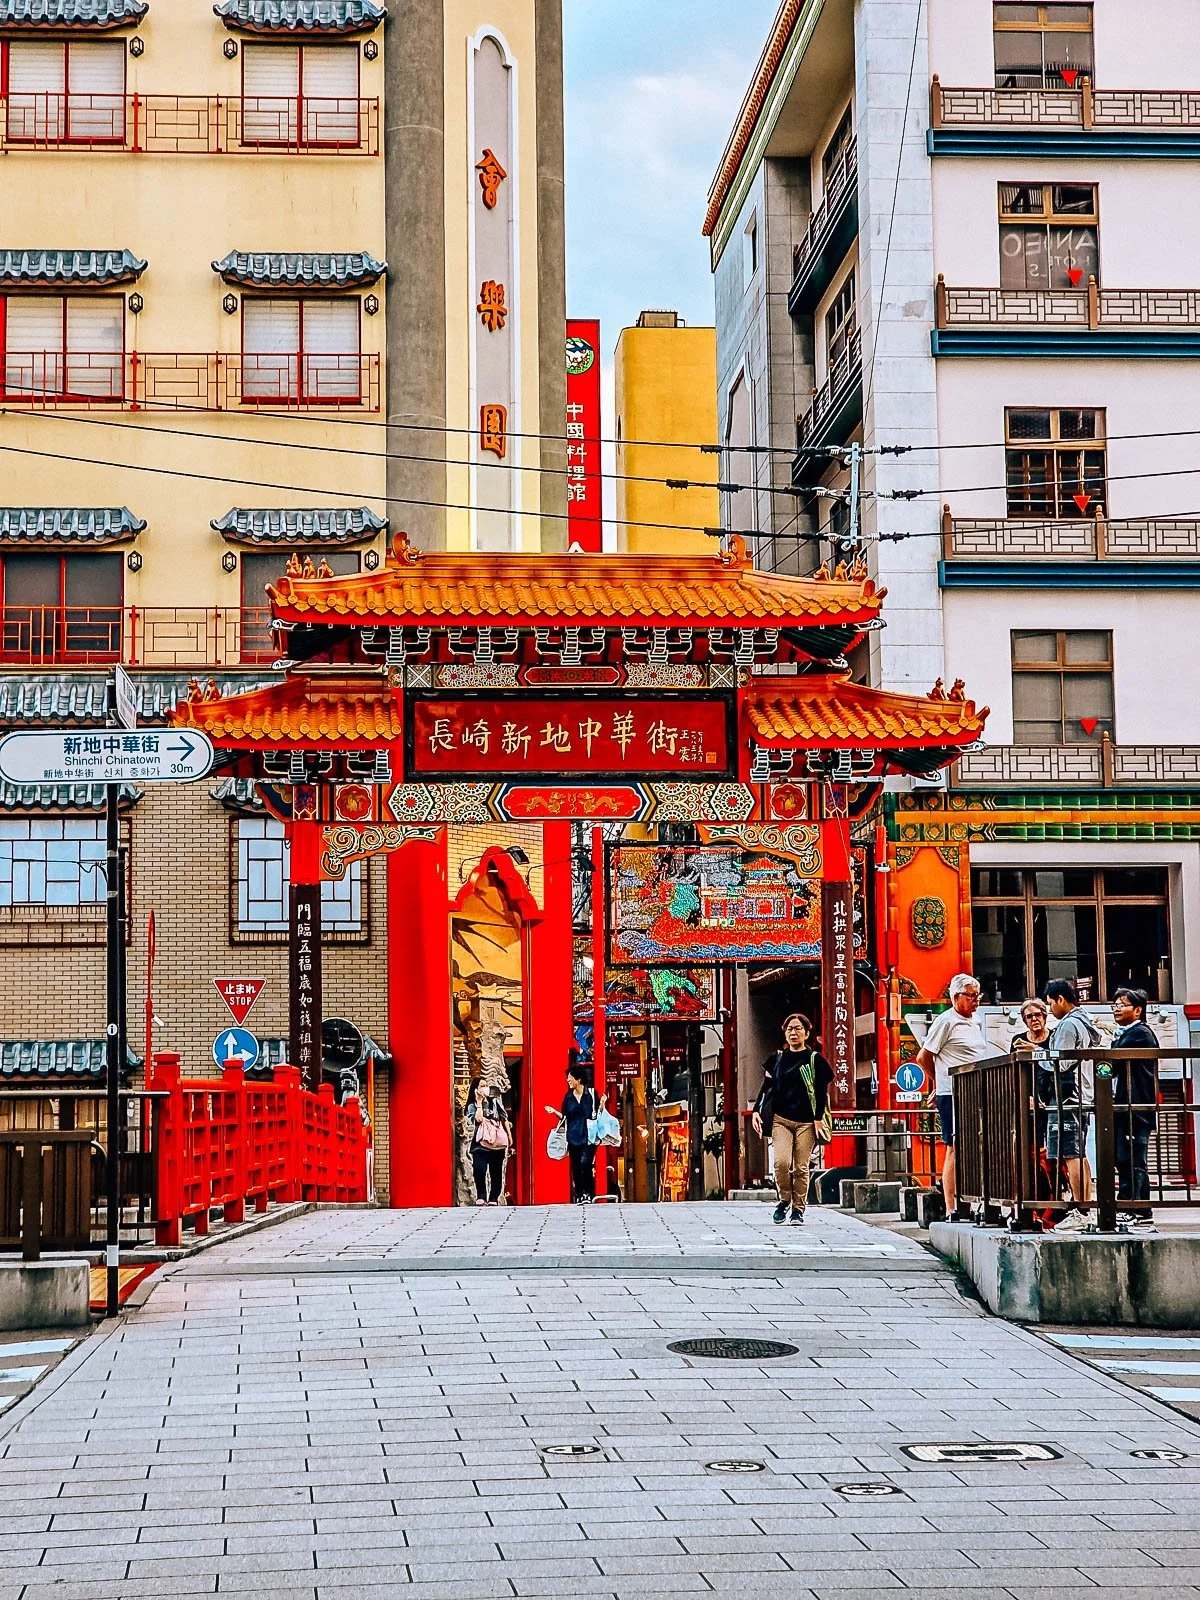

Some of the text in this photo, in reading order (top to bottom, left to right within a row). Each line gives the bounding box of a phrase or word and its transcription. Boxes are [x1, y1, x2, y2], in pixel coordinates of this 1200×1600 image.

[429, 710, 678, 760] 長崎新地中華街
[64, 736, 159, 754] 新地中華街
[64, 755, 161, 767] Shinchi Chinatown
[170, 763, 194, 774] 30m
[224, 984, 256, 995] 止まれ
[230, 997, 251, 1006] STOP
